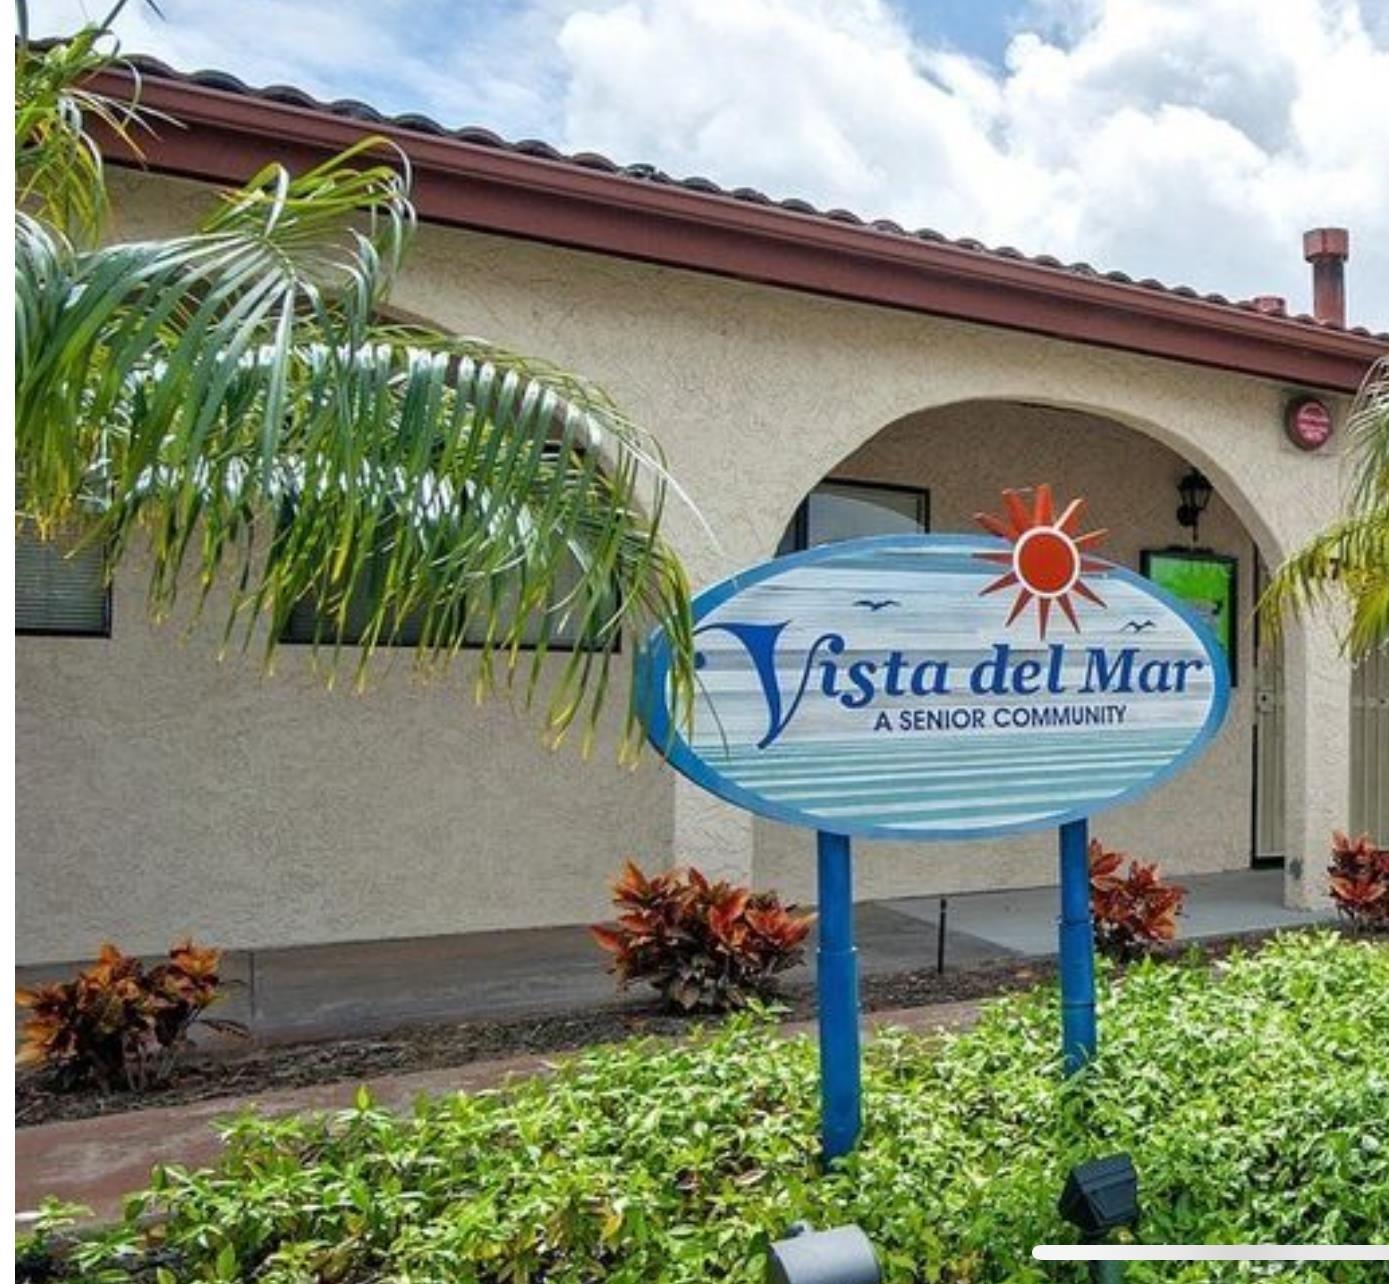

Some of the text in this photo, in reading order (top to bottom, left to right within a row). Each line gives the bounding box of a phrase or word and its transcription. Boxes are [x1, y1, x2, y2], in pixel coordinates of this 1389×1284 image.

[693, 619, 1204, 749] Vista del Mar
[873, 704, 1127, 732] A SENIOR COMMUNITY
